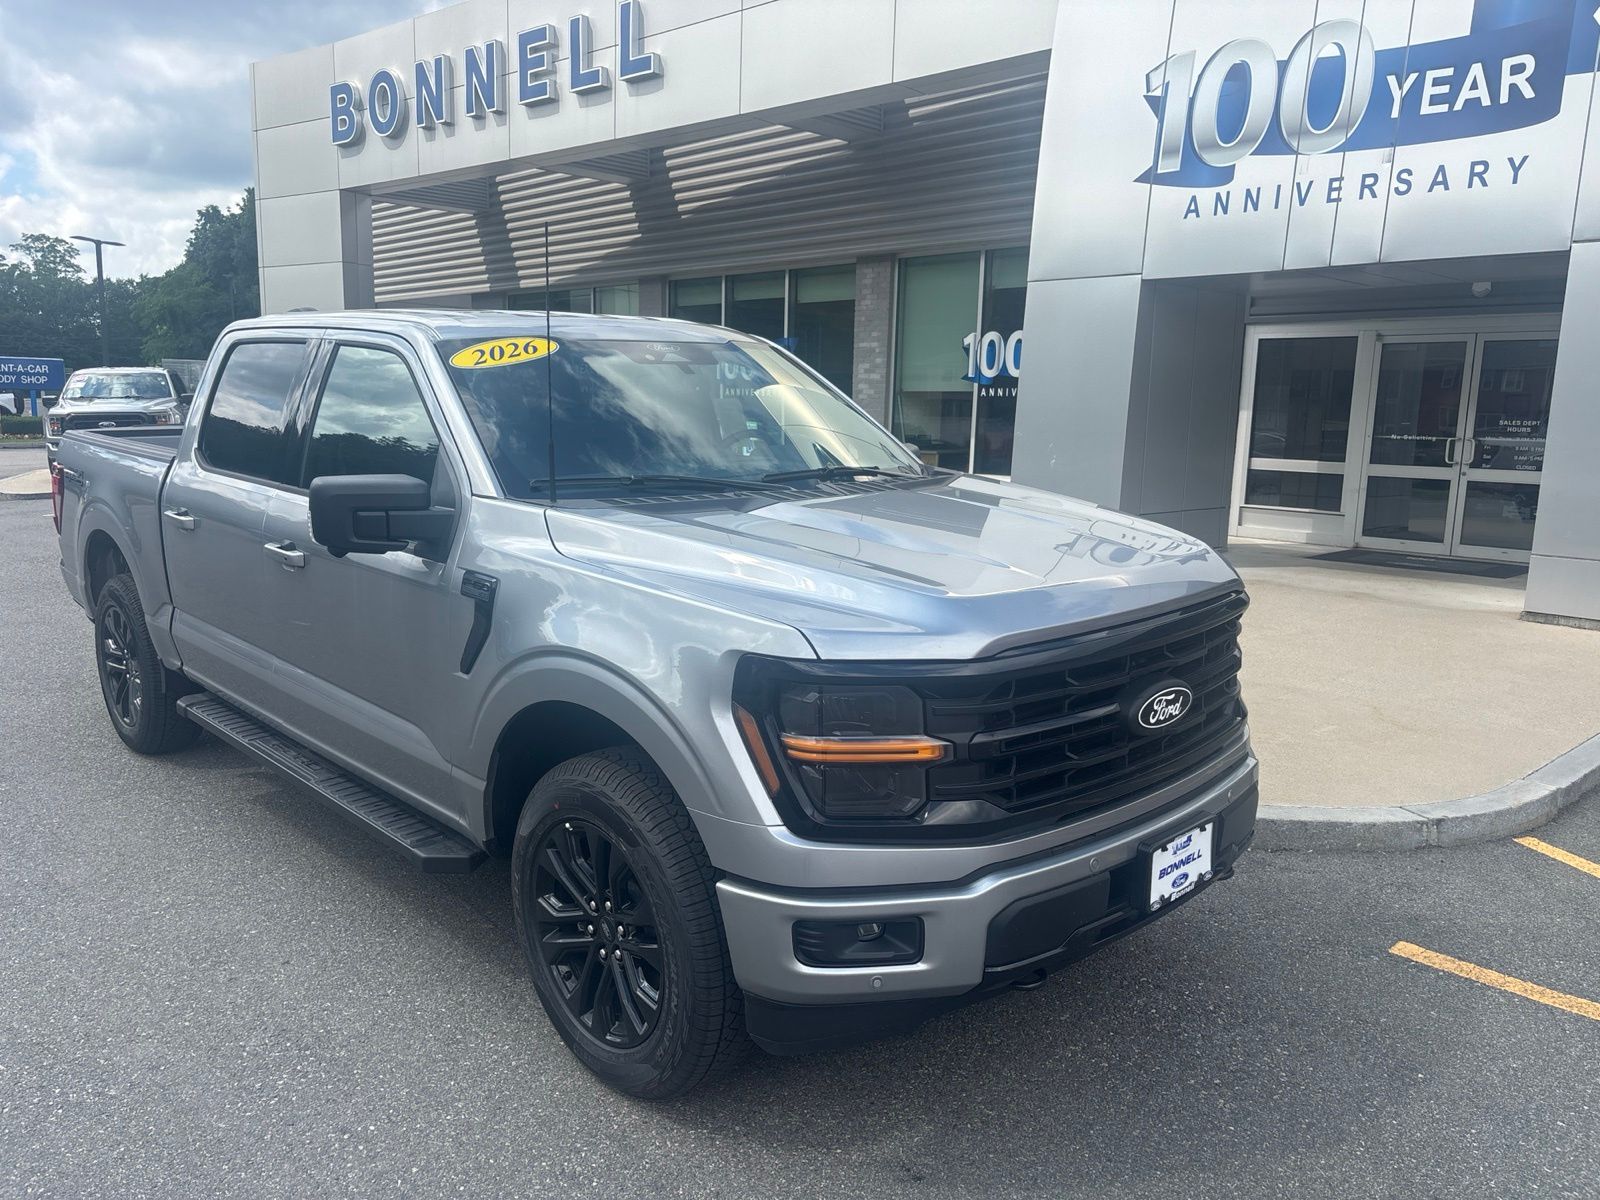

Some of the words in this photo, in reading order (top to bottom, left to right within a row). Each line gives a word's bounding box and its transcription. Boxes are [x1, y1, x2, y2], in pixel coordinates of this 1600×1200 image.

[329, 0, 660, 146] BONNELL
[1145, 18, 1376, 174] 100
[1386, 53, 1537, 119] YEAR
[1183, 155, 1530, 220] ANNIVERSARY
[0, 363, 49, 373] NT-A-CAR
[472, 340, 538, 366] 2026
[21, 375, 48, 384] SHOP
[980, 387, 1018, 397] ANNIV
[1150, 693, 1182, 724] Ford
[1158, 848, 1203, 881] BONNELL
